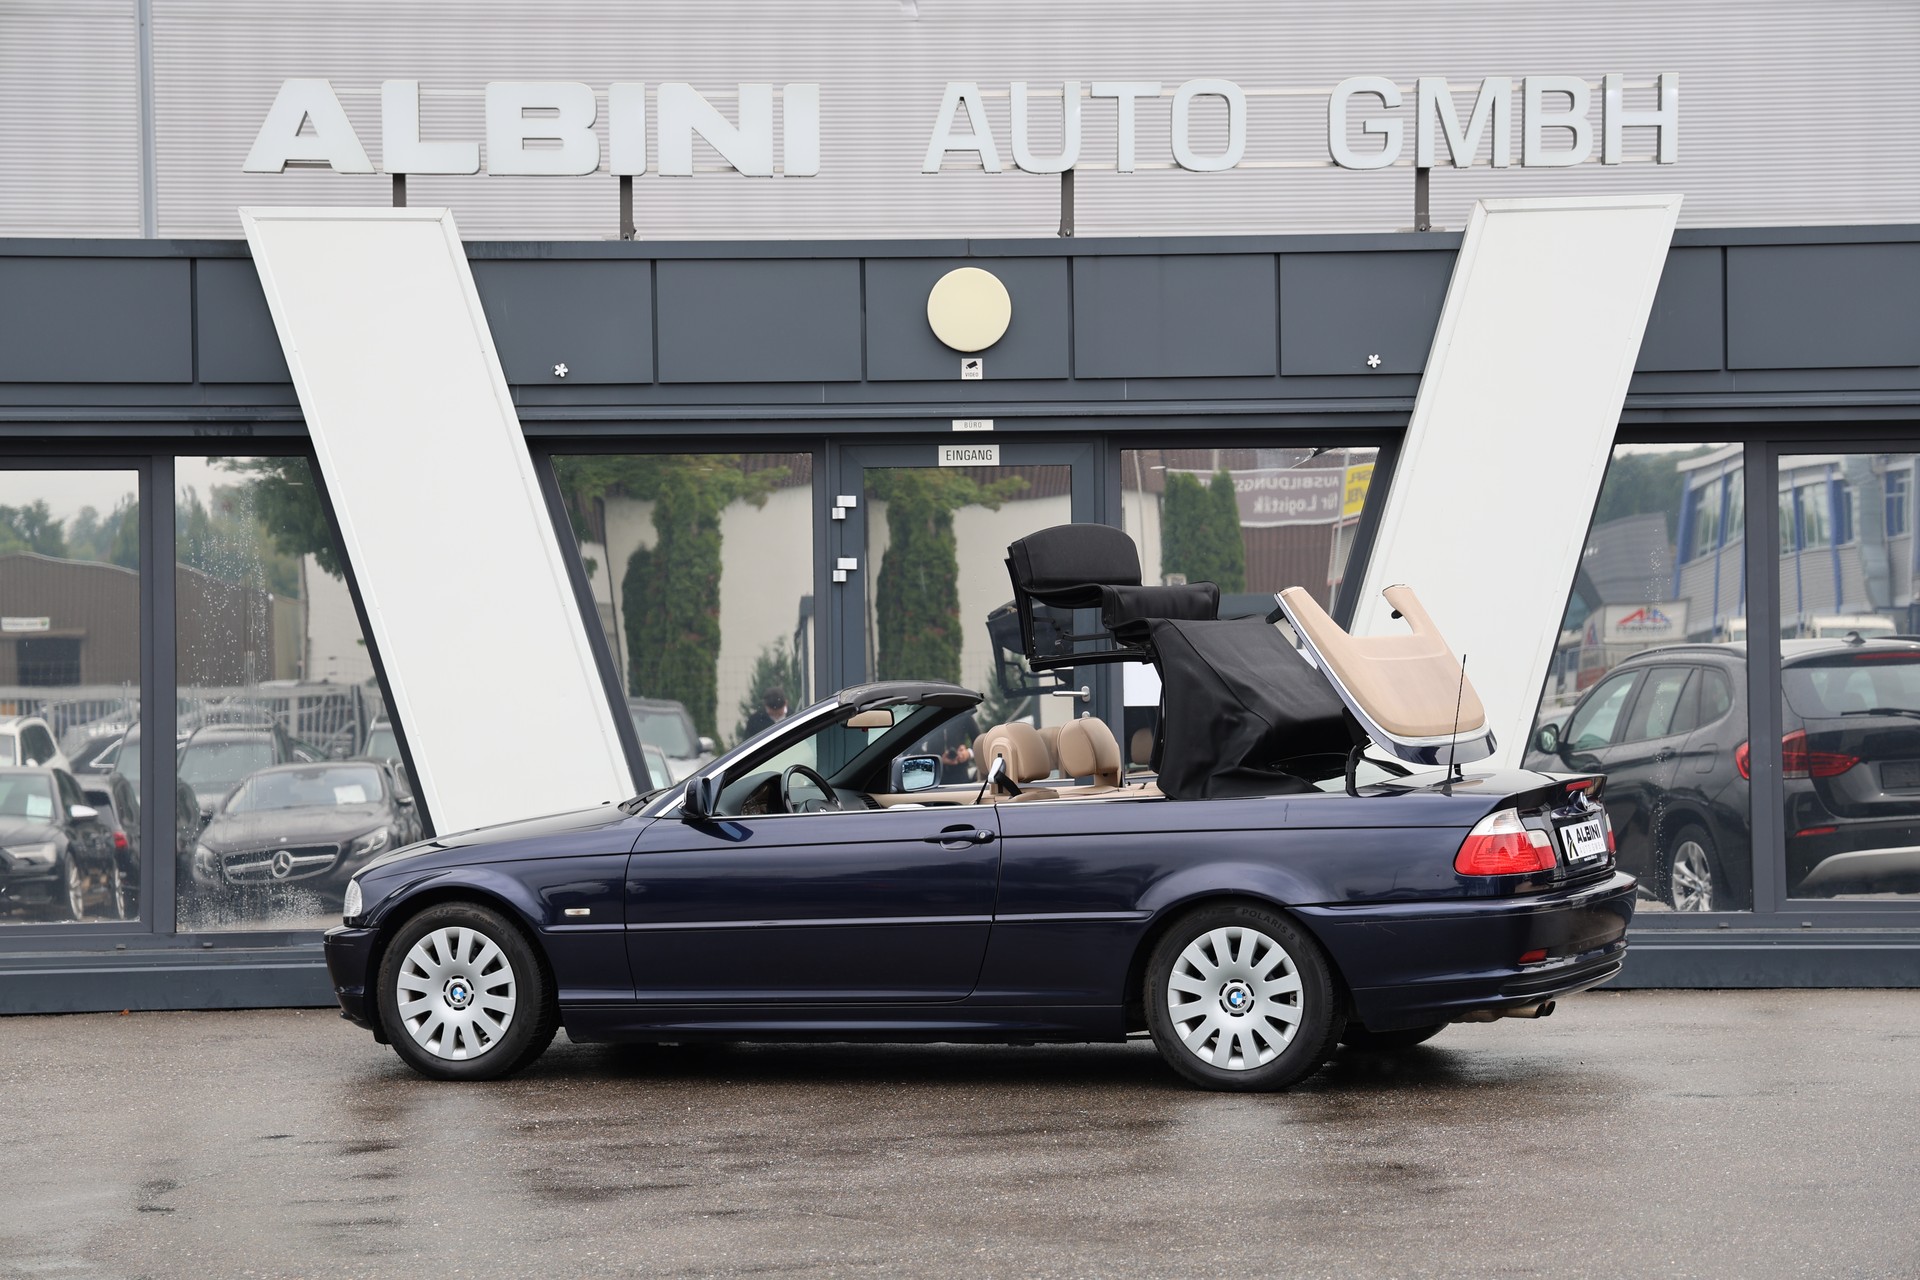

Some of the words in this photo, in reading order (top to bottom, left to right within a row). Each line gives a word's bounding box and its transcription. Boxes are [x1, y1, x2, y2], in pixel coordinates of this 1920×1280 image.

[242, 78, 820, 178] ALBINI
[921, 78, 1247, 174] AUTO
[1327, 72, 1680, 171] GMBH
[963, 420, 982, 429] BÜRO
[946, 449, 993, 461] EINGANG
[1576, 823, 1602, 844] ALBINI
[1242, 907, 1288, 934] POLARIS
